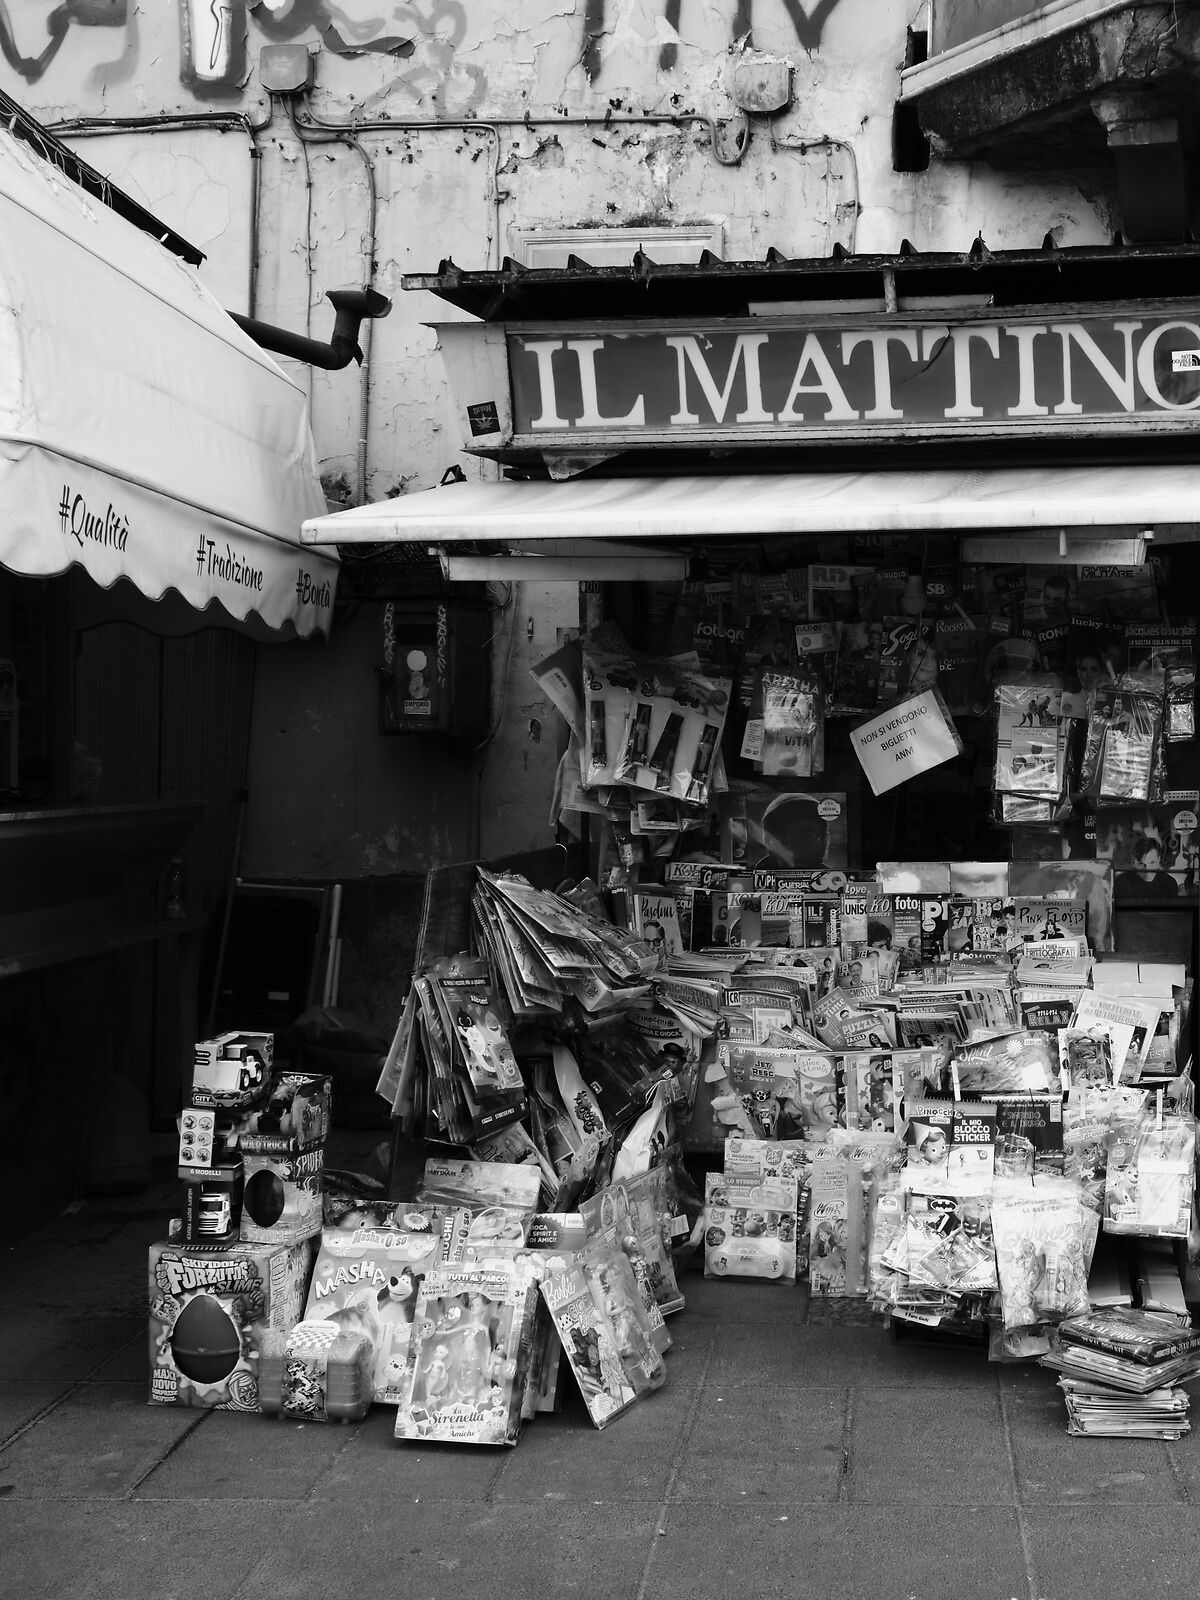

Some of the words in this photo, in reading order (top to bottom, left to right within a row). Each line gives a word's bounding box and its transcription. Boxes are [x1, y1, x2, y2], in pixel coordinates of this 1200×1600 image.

[525, 339, 646, 428] IL
[59, 485, 130, 552] #Qualità
[197, 532, 264, 593] #Tradizione
[296, 567, 332, 609] #Bontà
[860, 730, 879, 746] NON
[879, 726, 887, 737] SI
[885, 705, 929, 732] VENDONO
[880, 727, 918, 752] BIGLIETTI
[1020, 907, 1043, 924] PINK
[1045, 907, 1084, 926] FLOYD
[842, 1015, 881, 1035] PUZZLE
[1027, 1011, 1069, 1027] RELAX
[755, 1060, 772, 1069] JET
[195, 1095, 211, 1103] CITY
[953, 1125, 990, 1134] BLOCCO
[953, 1133, 991, 1142] STICKER
[262, 1141, 289, 1150] TRUCK
[296, 1149, 324, 1177] SPIDER
[352, 1229, 380, 1245] Masha
[215, 1278, 263, 1295] SLIME
[314, 1260, 387, 1300] MASHA
[448, 1273, 469, 1282] TUTTI
[470, 1274, 481, 1282] AL
[481, 1274, 509, 1284] PARCO!
[514, 1289, 526, 1299] 3+
[545, 1274, 576, 1307] Barbie
[153, 1368, 177, 1379] MAXI
[153, 1378, 177, 1390] UOVO
[429, 1411, 485, 1426] Sirenetta
